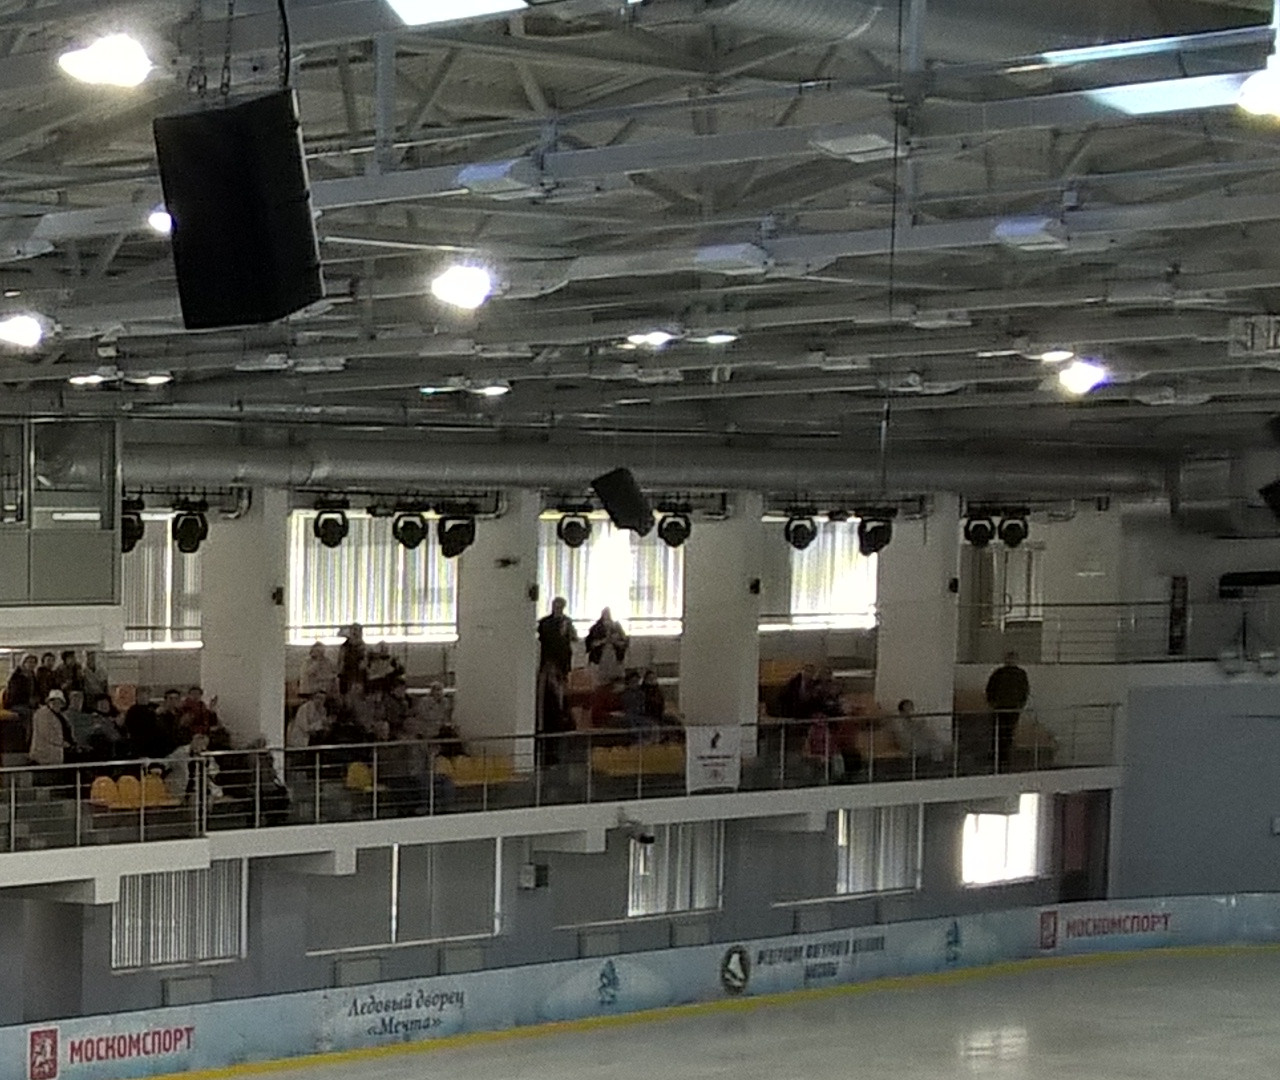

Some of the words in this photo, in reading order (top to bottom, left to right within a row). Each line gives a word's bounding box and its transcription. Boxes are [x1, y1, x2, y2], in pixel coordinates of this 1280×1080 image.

[347, 992, 413, 1017] Ледовый
[416, 988, 465, 1012] дворец
[69, 1026, 196, 1064] МОСКОМСПОРТ
